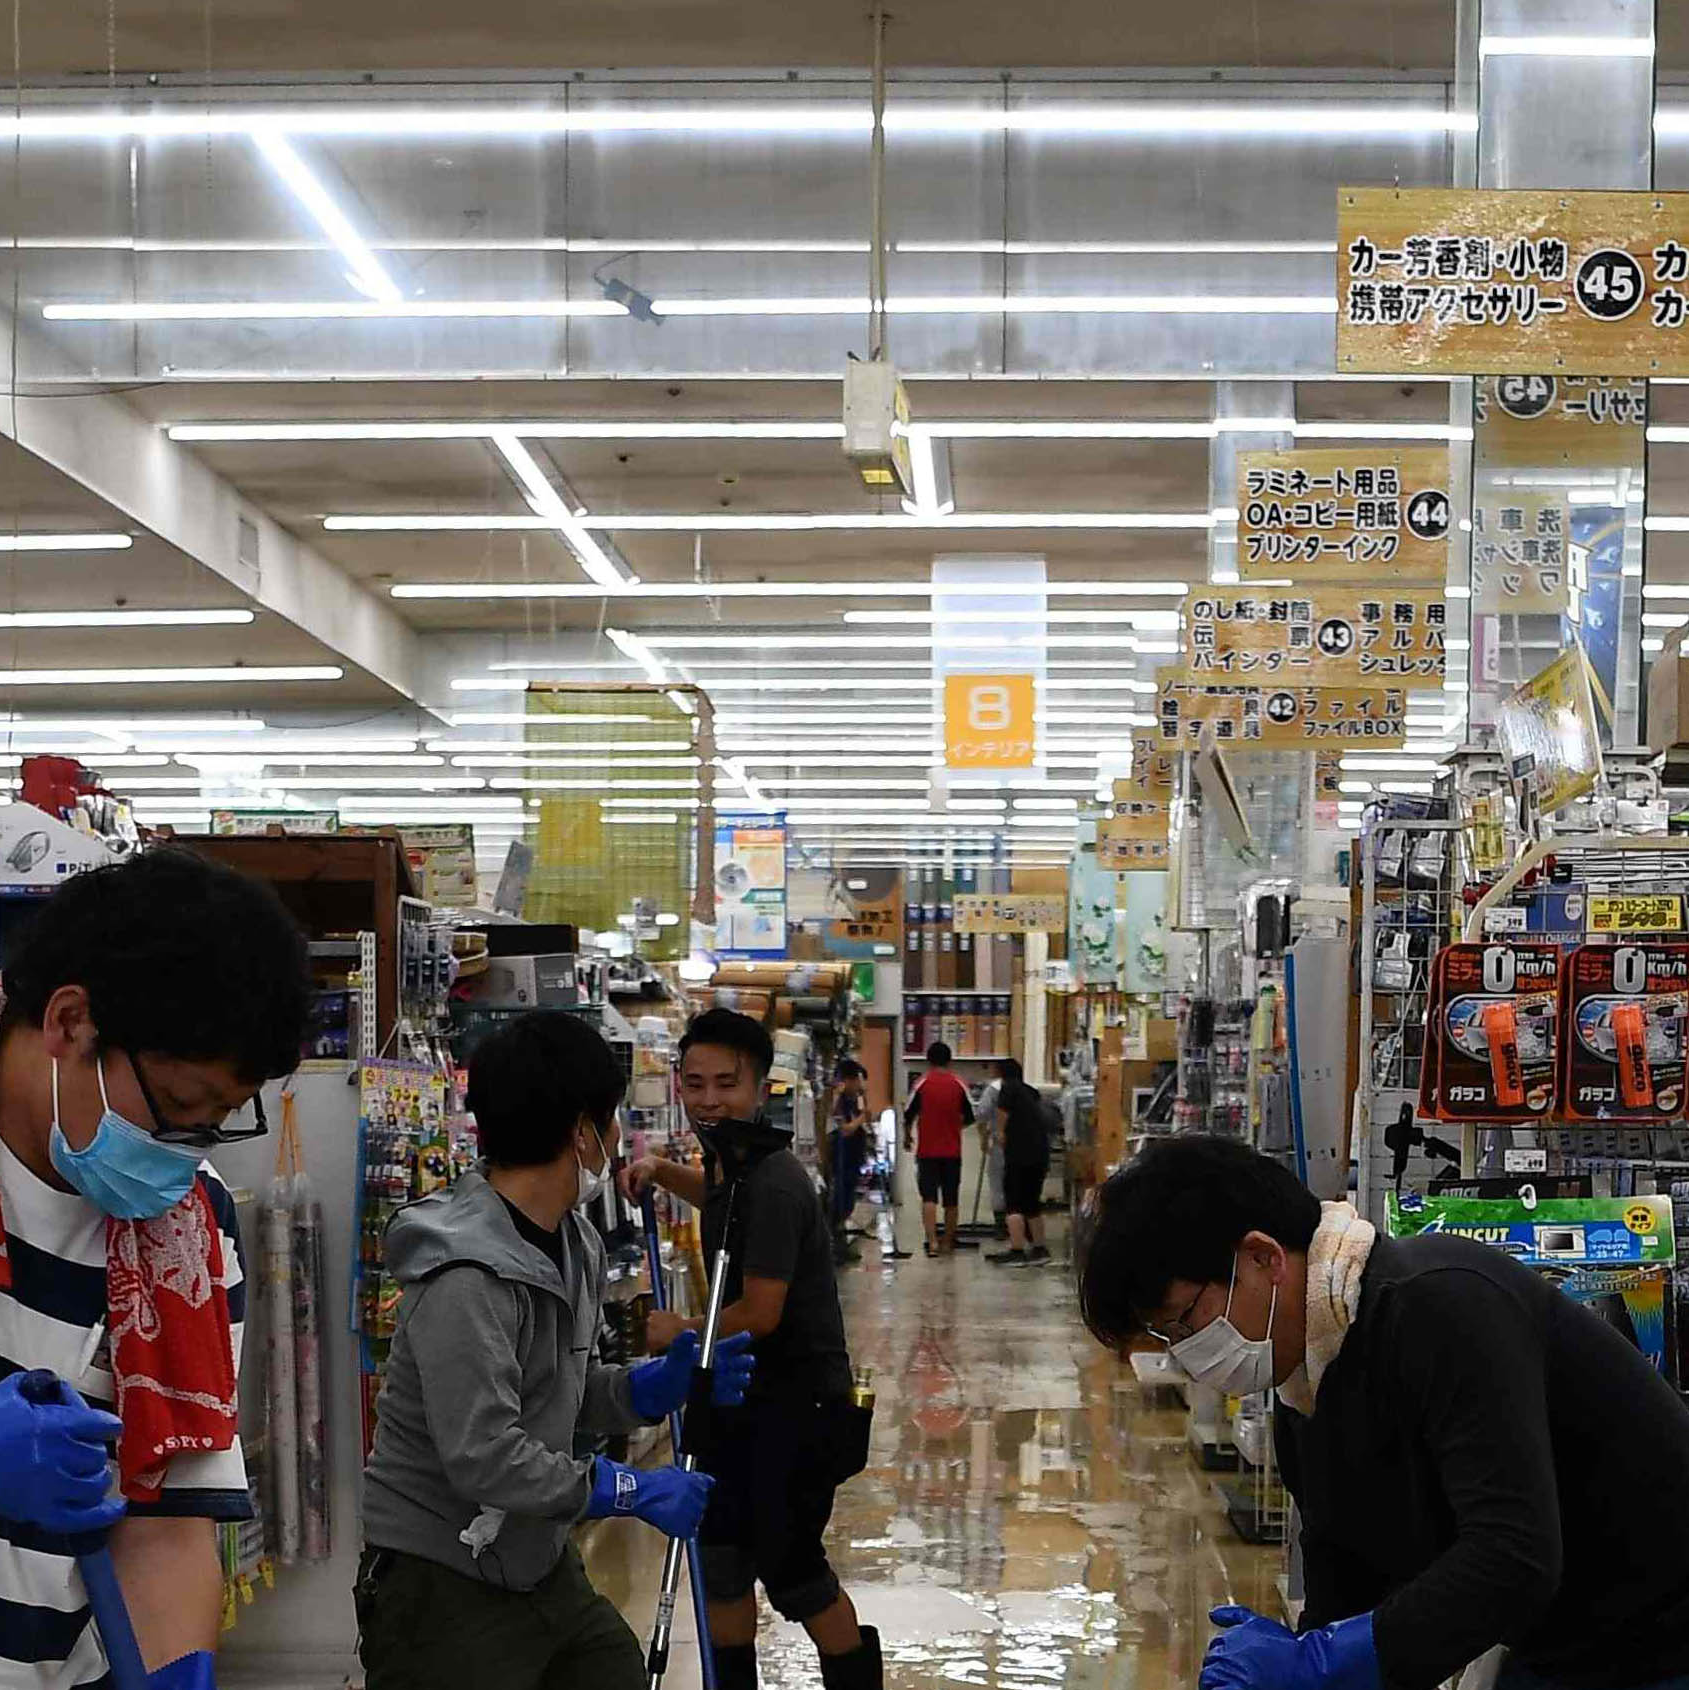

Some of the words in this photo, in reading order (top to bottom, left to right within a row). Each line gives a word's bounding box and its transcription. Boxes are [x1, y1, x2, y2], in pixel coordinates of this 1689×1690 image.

[1584, 266, 1635, 302] 45
[1350, 284, 1566, 324] 携帯アクセサリー
[1247, 470, 1399, 495] ラミネート用品
[1246, 502, 1399, 527] OA・コピー用紙
[1412, 501, 1449, 527] 44
[1246, 534, 1398, 561] プリンターインク
[1320, 627, 1352, 648] 43
[1194, 652, 1310, 671] バインダー
[967, 686, 1011, 732] 8
[1268, 699, 1296, 717] 42
[1303, 721, 1404, 737] ファイルBOX
[947, 741, 1032, 758] インテリア
[1448, 1085, 1486, 1102] ガラコ
[1578, 1086, 1615, 1103] ガラコ
